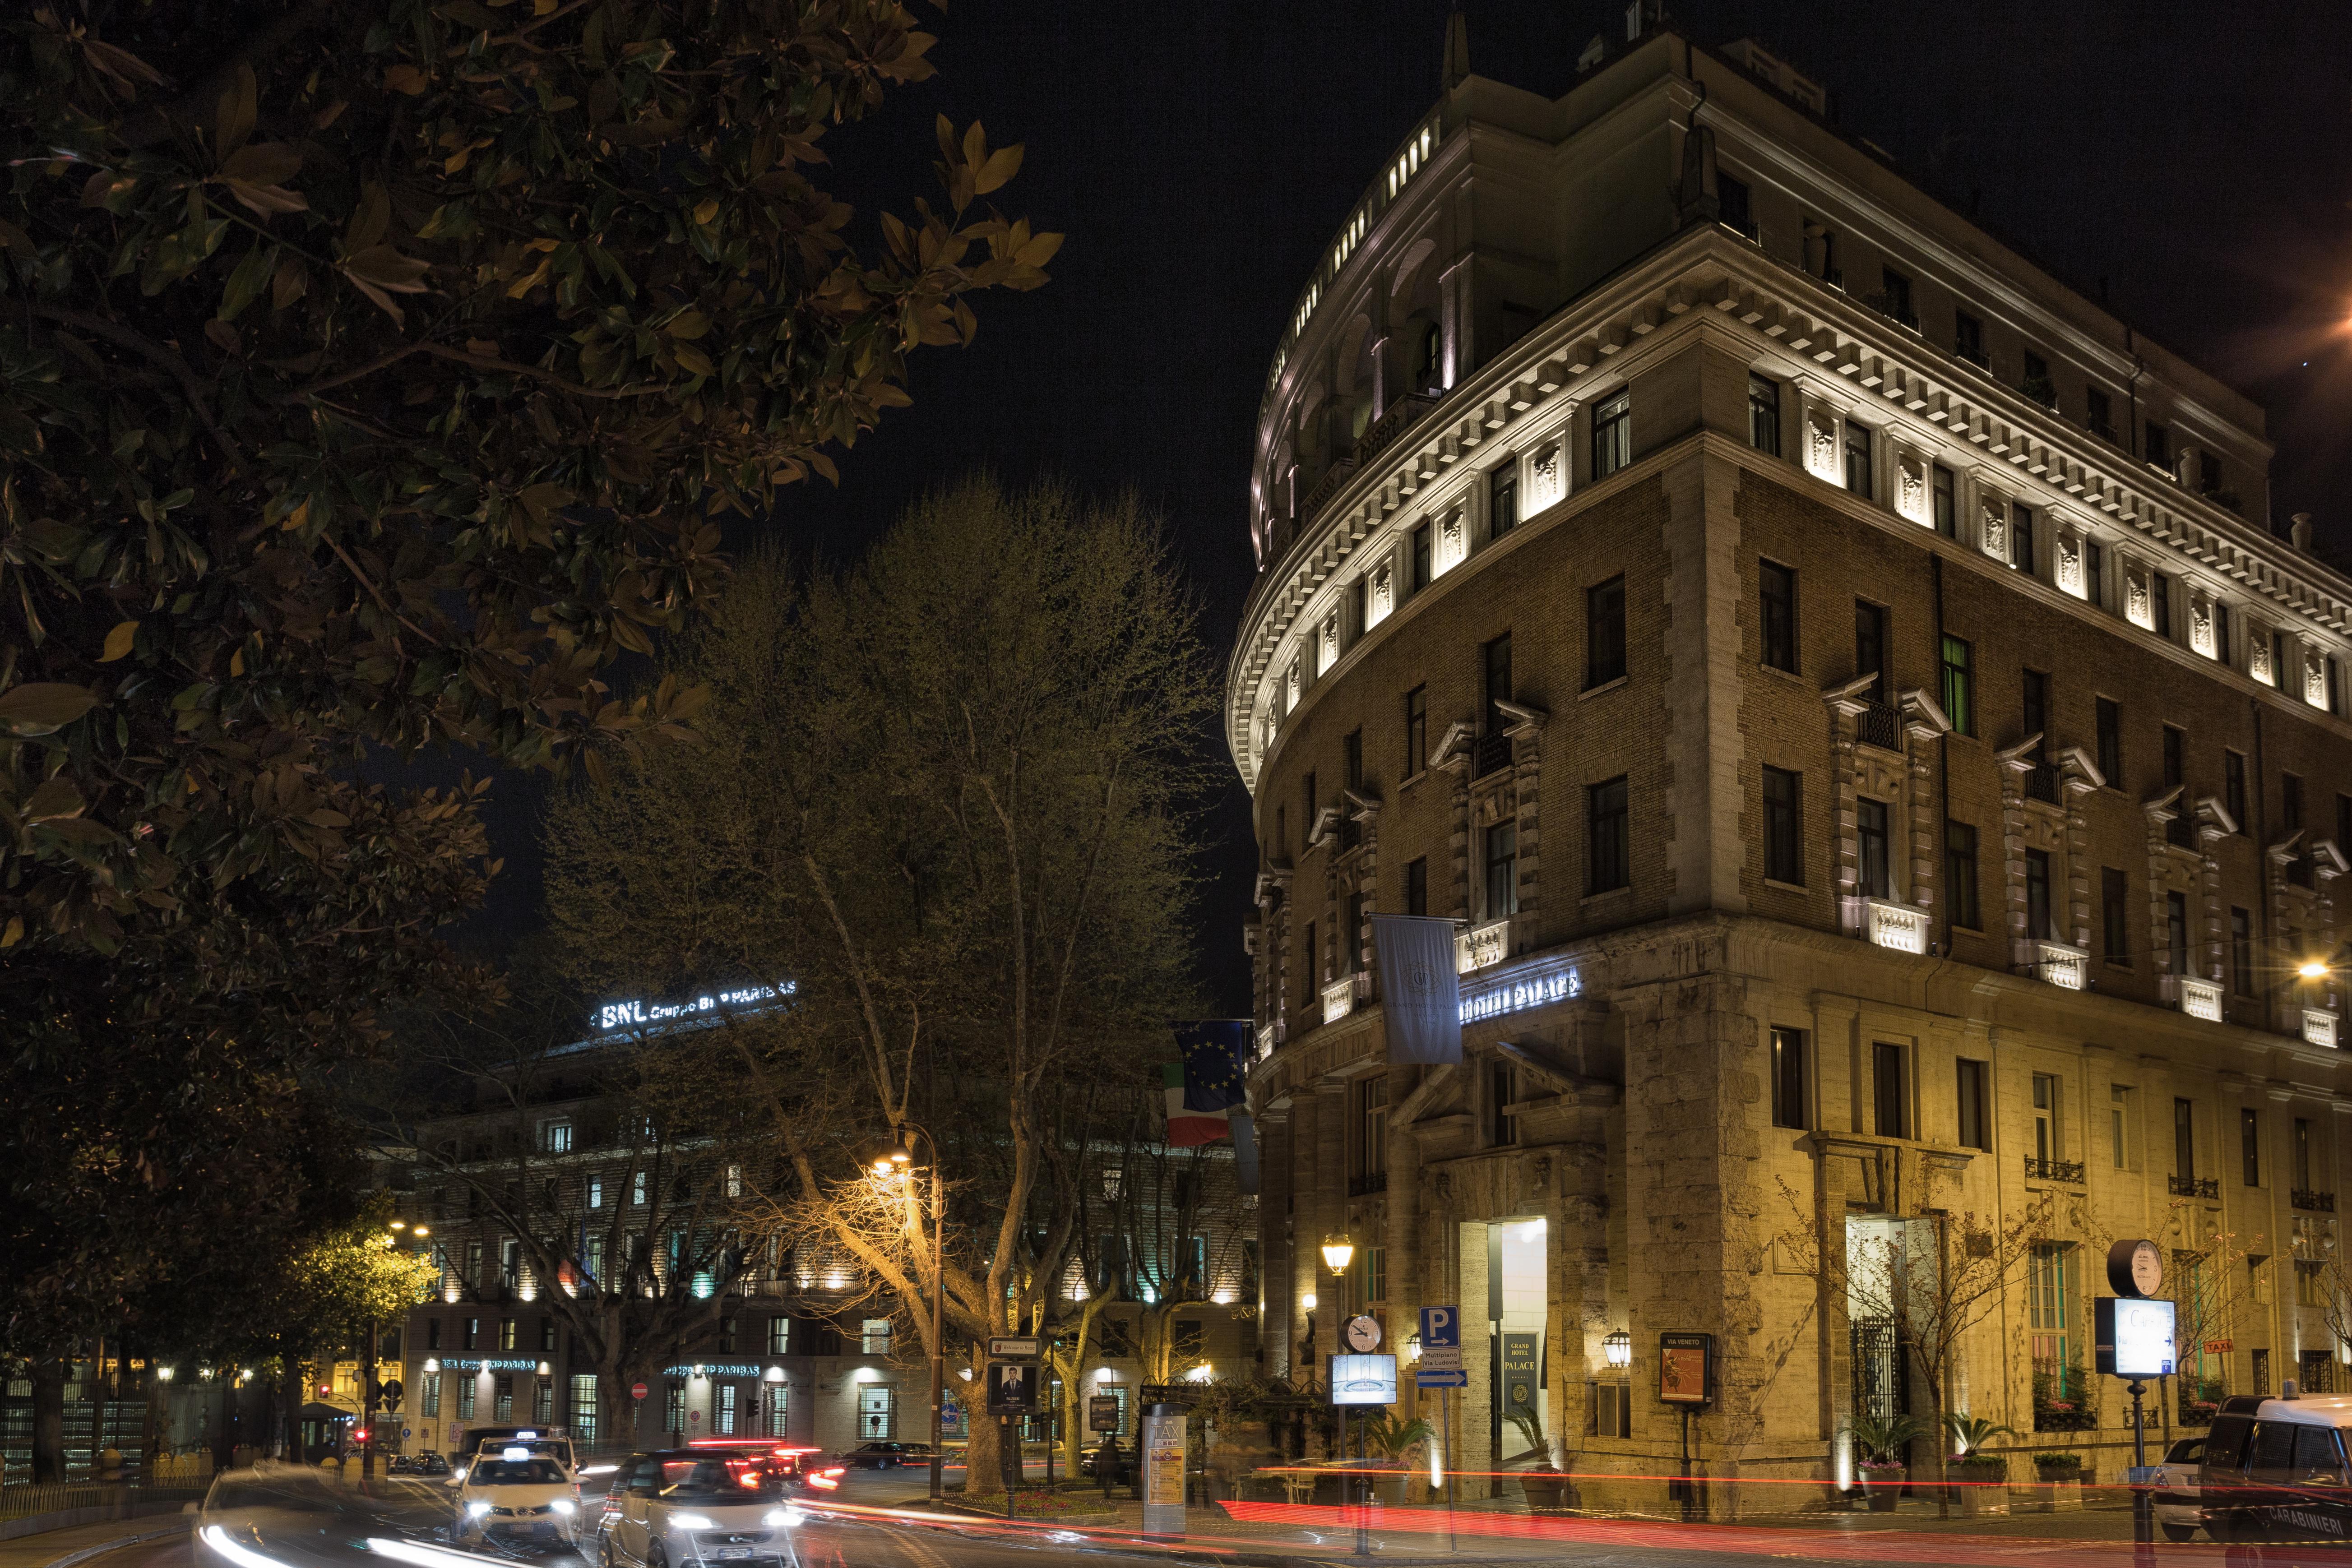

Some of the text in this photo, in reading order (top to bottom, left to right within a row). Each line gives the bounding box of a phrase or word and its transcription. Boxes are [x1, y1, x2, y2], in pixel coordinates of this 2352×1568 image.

[1463, 976, 1578, 1021] HOTEL PALACE
[602, 1000, 647, 1028] BNL
[650, 1003, 696, 1018] Gruppo
[1429, 1309, 1449, 1337] P
[503, 1361, 535, 1369] PARIBAS
[718, 1366, 759, 1376] PARIBAS
[1505, 1361, 1535, 1370] PALACE
[1151, 1425, 1183, 1438] TAXI
[2269, 1506, 2344, 1535] CARABINIERI
